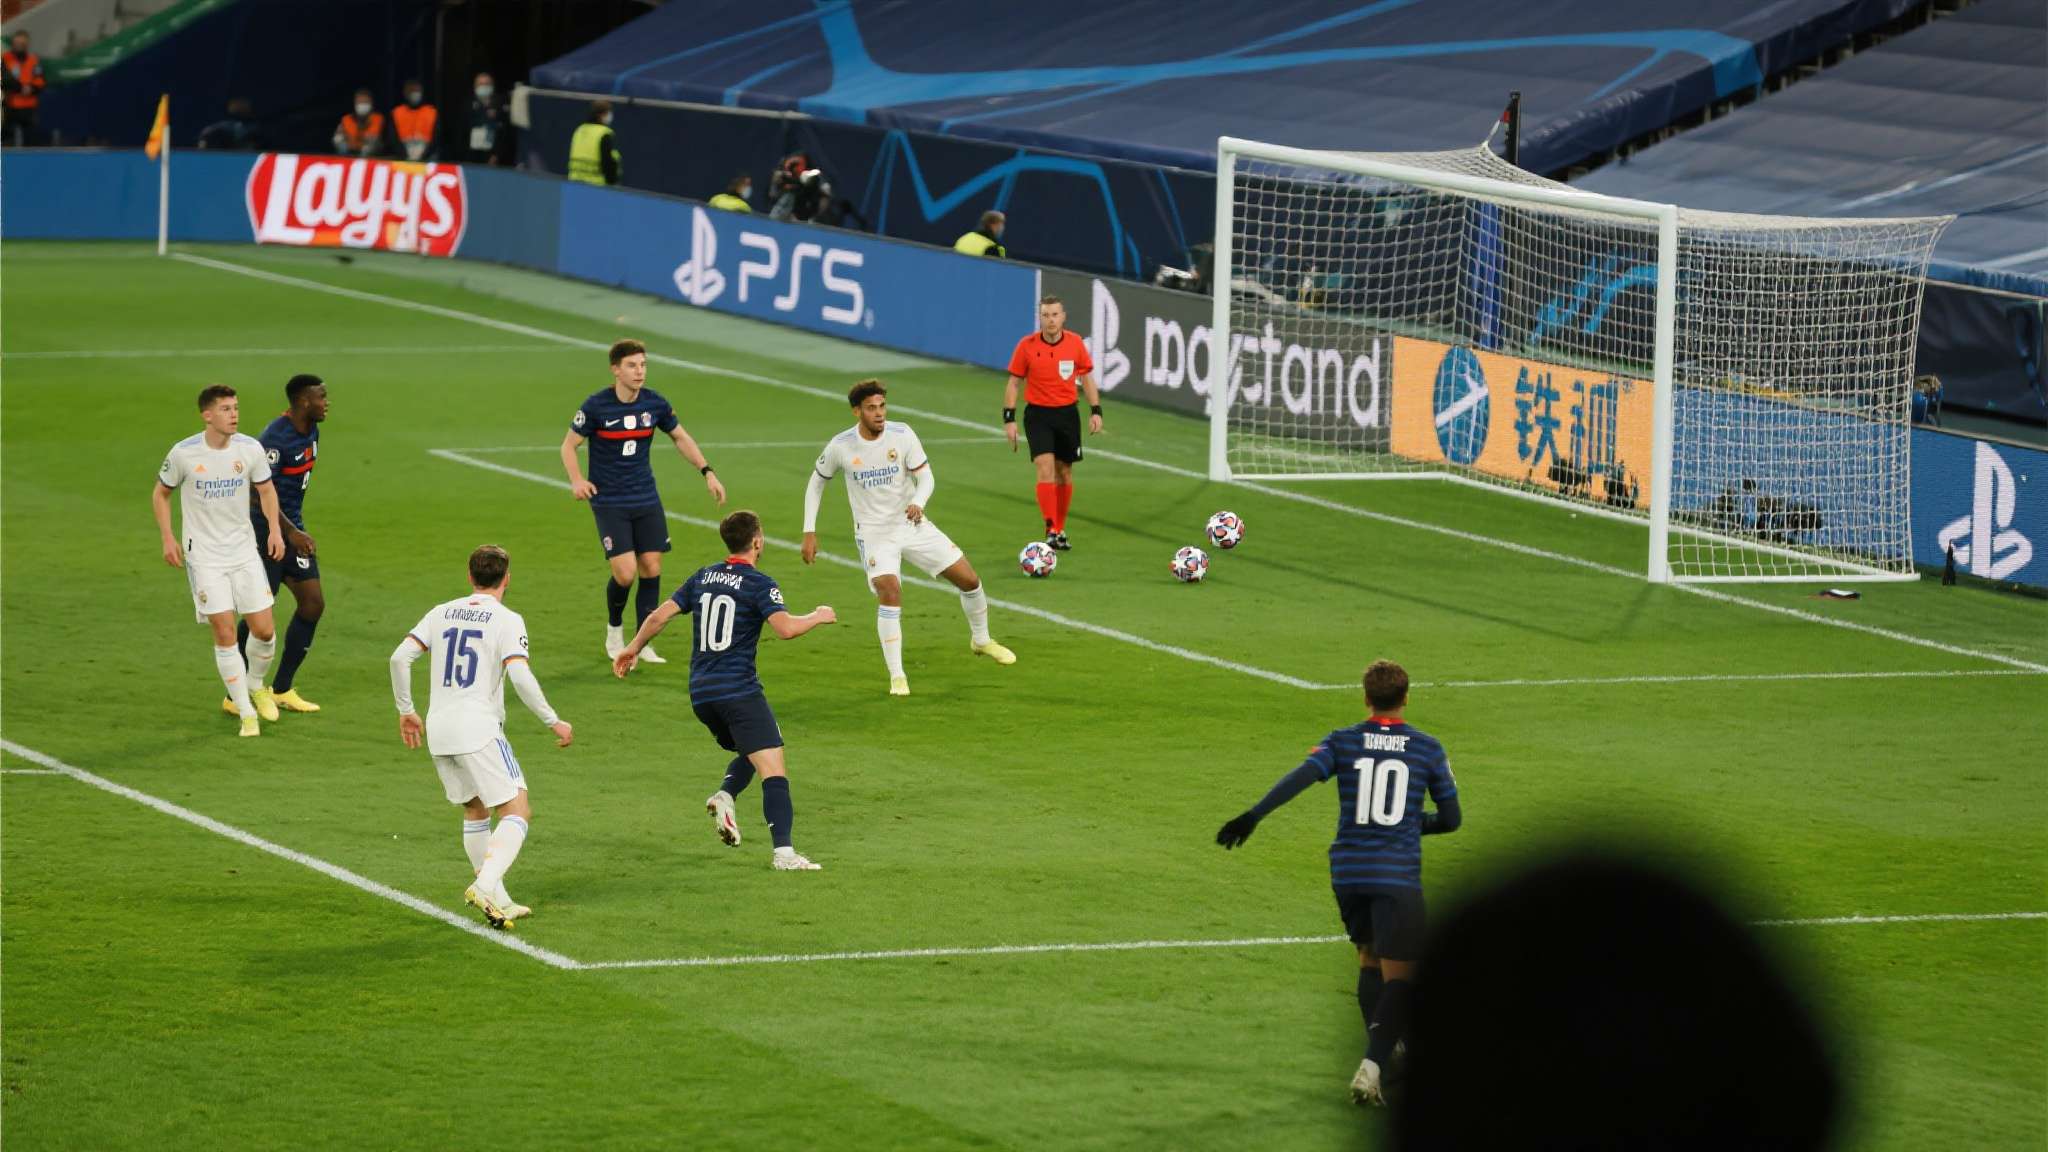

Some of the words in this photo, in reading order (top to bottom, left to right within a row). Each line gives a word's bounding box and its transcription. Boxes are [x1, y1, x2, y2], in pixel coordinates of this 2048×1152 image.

[699, 592, 736, 652] 10
[443, 627, 483, 688] 15
[1353, 757, 1410, 826] 10
